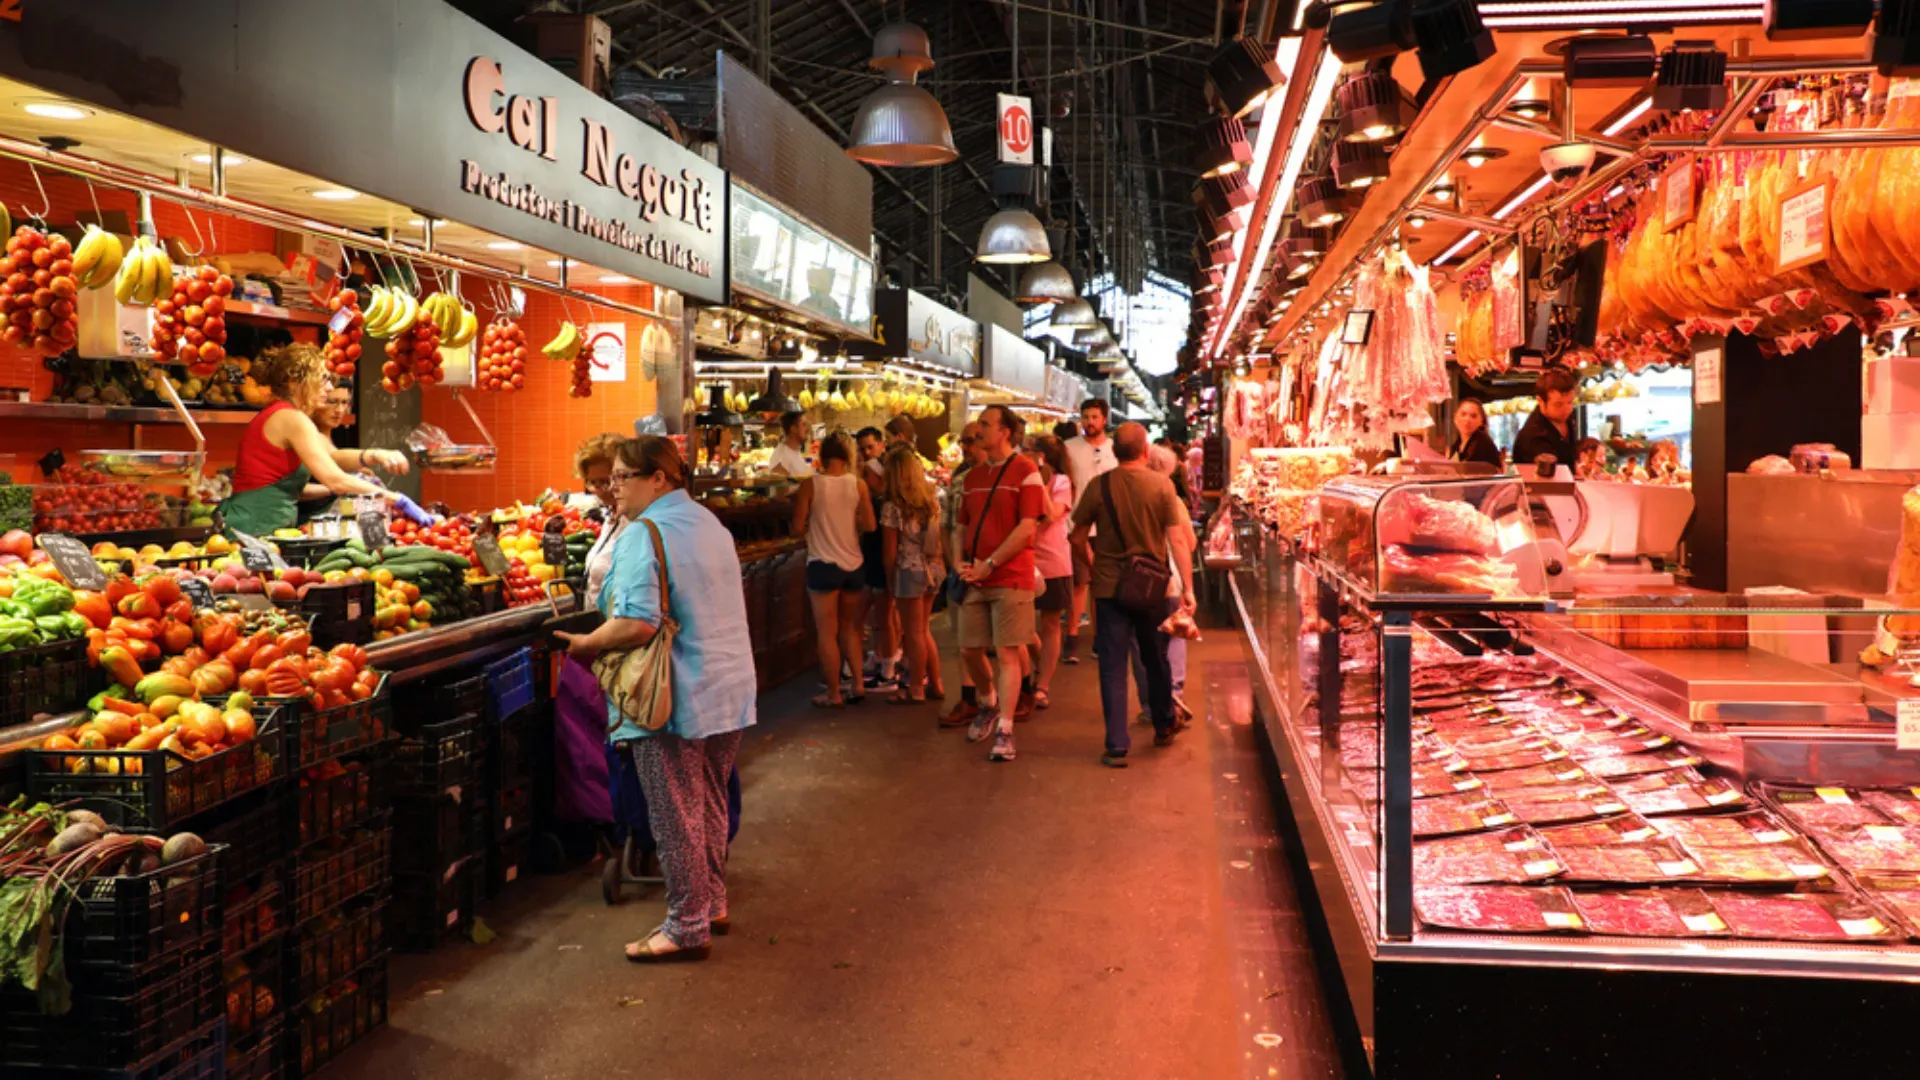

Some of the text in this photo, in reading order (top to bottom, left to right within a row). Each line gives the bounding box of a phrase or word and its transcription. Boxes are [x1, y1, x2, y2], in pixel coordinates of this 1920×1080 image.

[463, 56, 712, 233] Cal Neguit
[1003, 113, 1031, 146] 10
[460, 159, 561, 223] Productors
[562, 199, 573, 229] i
[645, 232, 663, 260] de
